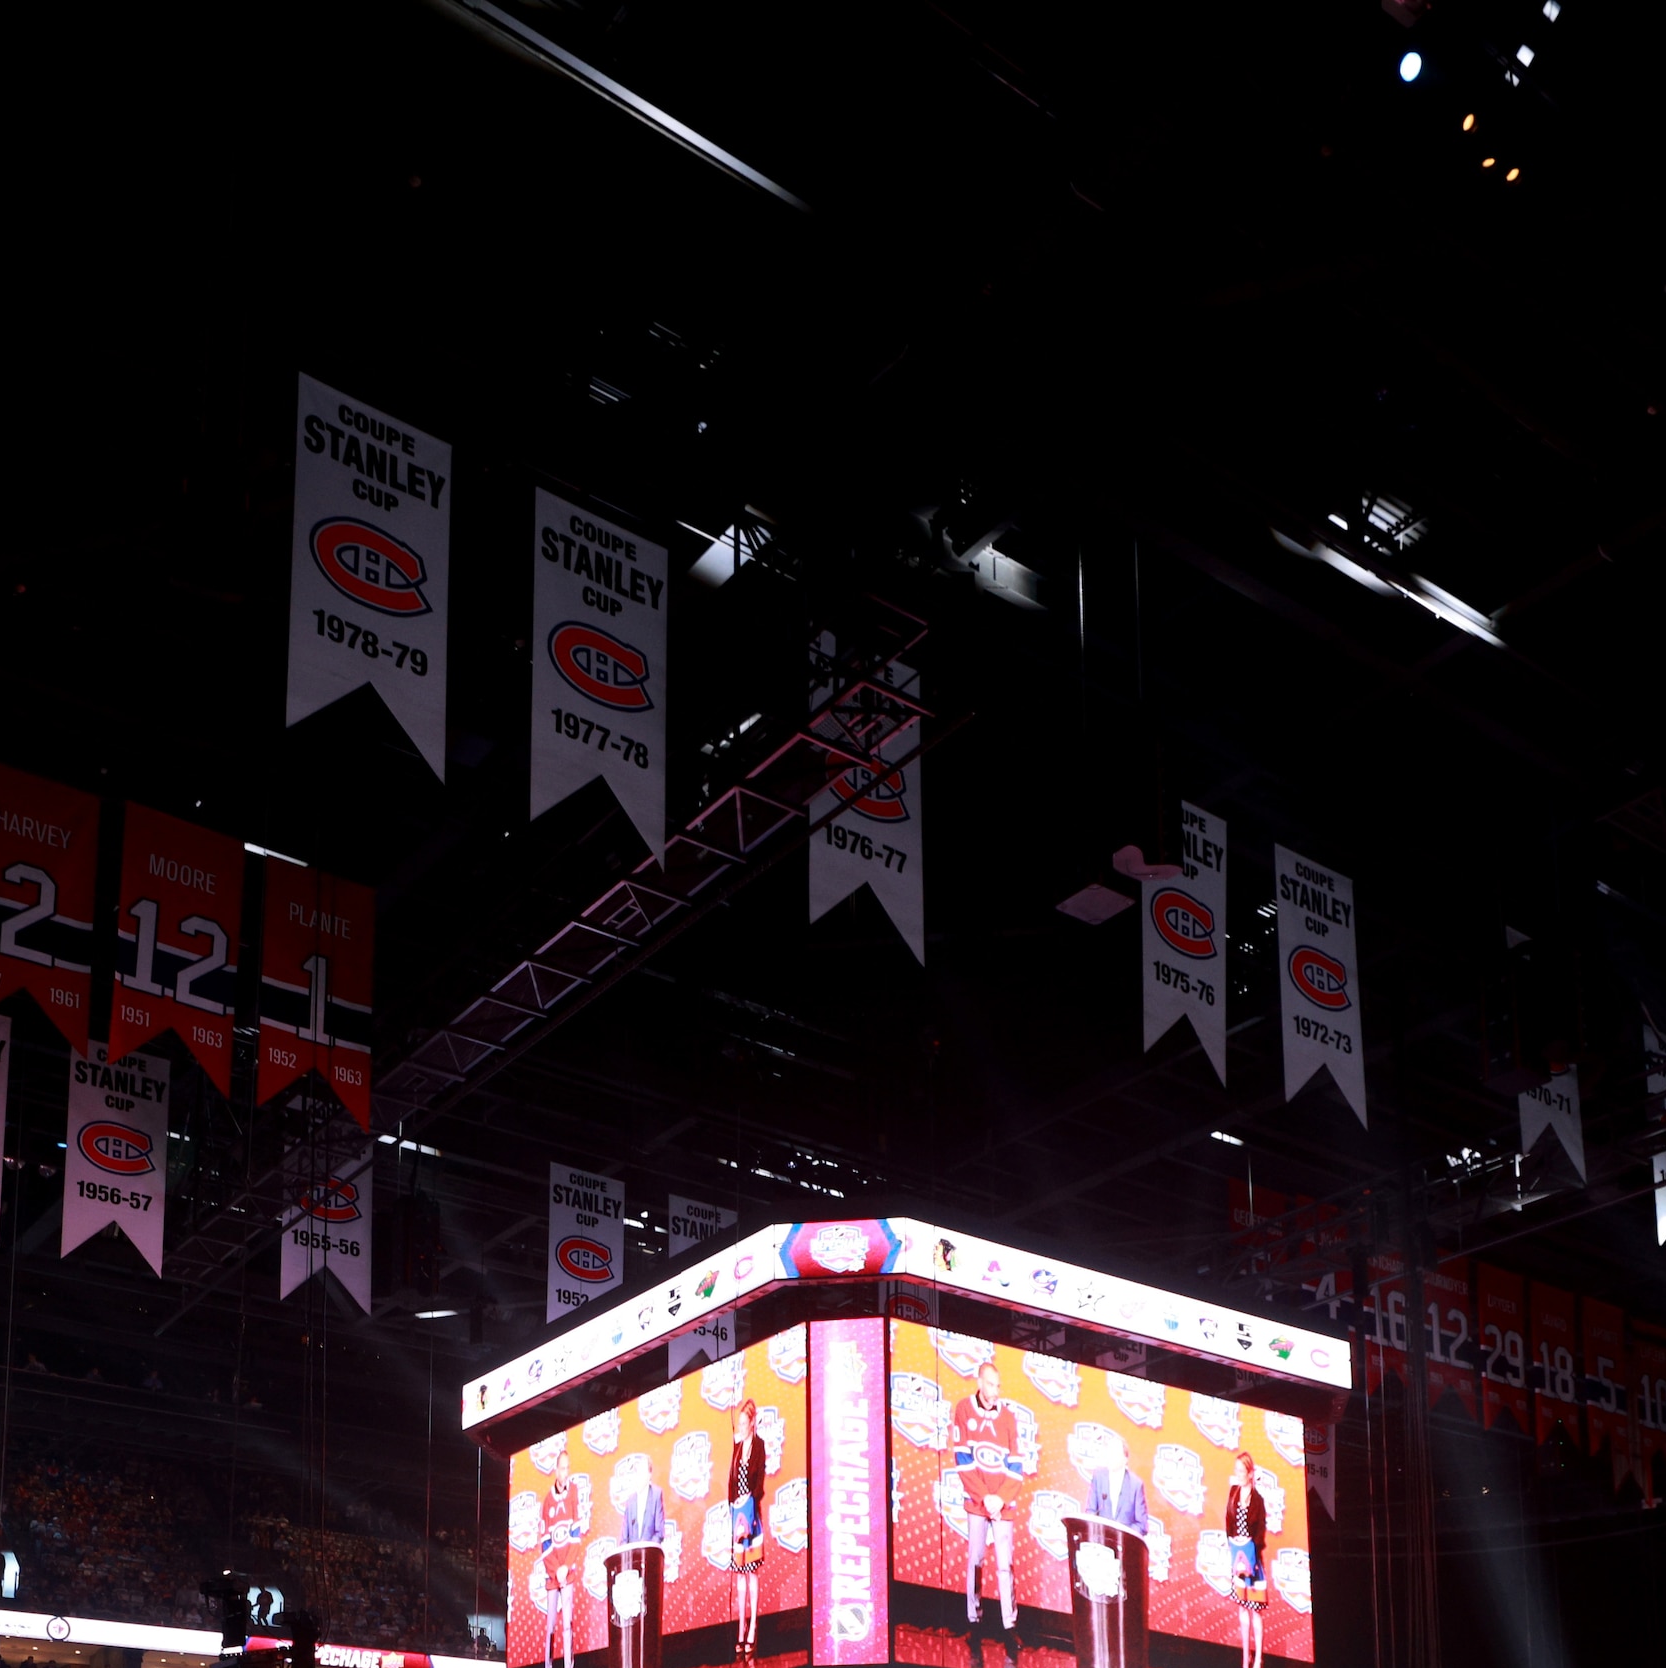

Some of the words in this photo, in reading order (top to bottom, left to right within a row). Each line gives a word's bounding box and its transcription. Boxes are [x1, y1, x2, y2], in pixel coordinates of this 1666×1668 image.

[338, 404, 415, 457] COUPE
[303, 414, 445, 509] STANLEY
[352, 479, 399, 512] CUP
[569, 514, 638, 562] COUPE
[541, 527, 665, 611] STANLEY
[582, 585, 624, 618] CUP
[313, 608, 429, 677] 1978-79
[550, 708, 650, 770] 1977-78
[822, 822, 908, 874] 1976-77
[148, 852, 217, 896] MOORE
[1295, 861, 1334, 893] COUPE
[0, 861, 58, 968] 2
[1280, 874, 1351, 928] STANLEY
[288, 902, 353, 942] PLANTE
[1305, 916, 1329, 938] CUP
[121, 898, 230, 1017] 12
[49, 986, 82, 1011] 1961
[296, 953, 334, 1047] 1
[1153, 960, 1215, 1006] 1975-76
[119, 1004, 151, 1029] 1951
[1293, 1015, 1353, 1054] 1972-73
[191, 1024, 224, 1050] 1963
[267, 1046, 297, 1071] 1952
[333, 1063, 364, 1088] 1963
[74, 1060, 166, 1103] STANLEY
[105, 1094, 135, 1112] CUP
[76, 1179, 153, 1212] 1956-57
[552, 1184, 622, 1220] STANLEY
[569, 1172, 608, 1193] COUPE
[575, 1213, 599, 1229] CUP
[686, 1203, 722, 1223] COUPE
[290, 1227, 361, 1258] 1955-56
[1483, 1324, 1526, 1389] 29
[1539, 1341, 1576, 1403] 18
